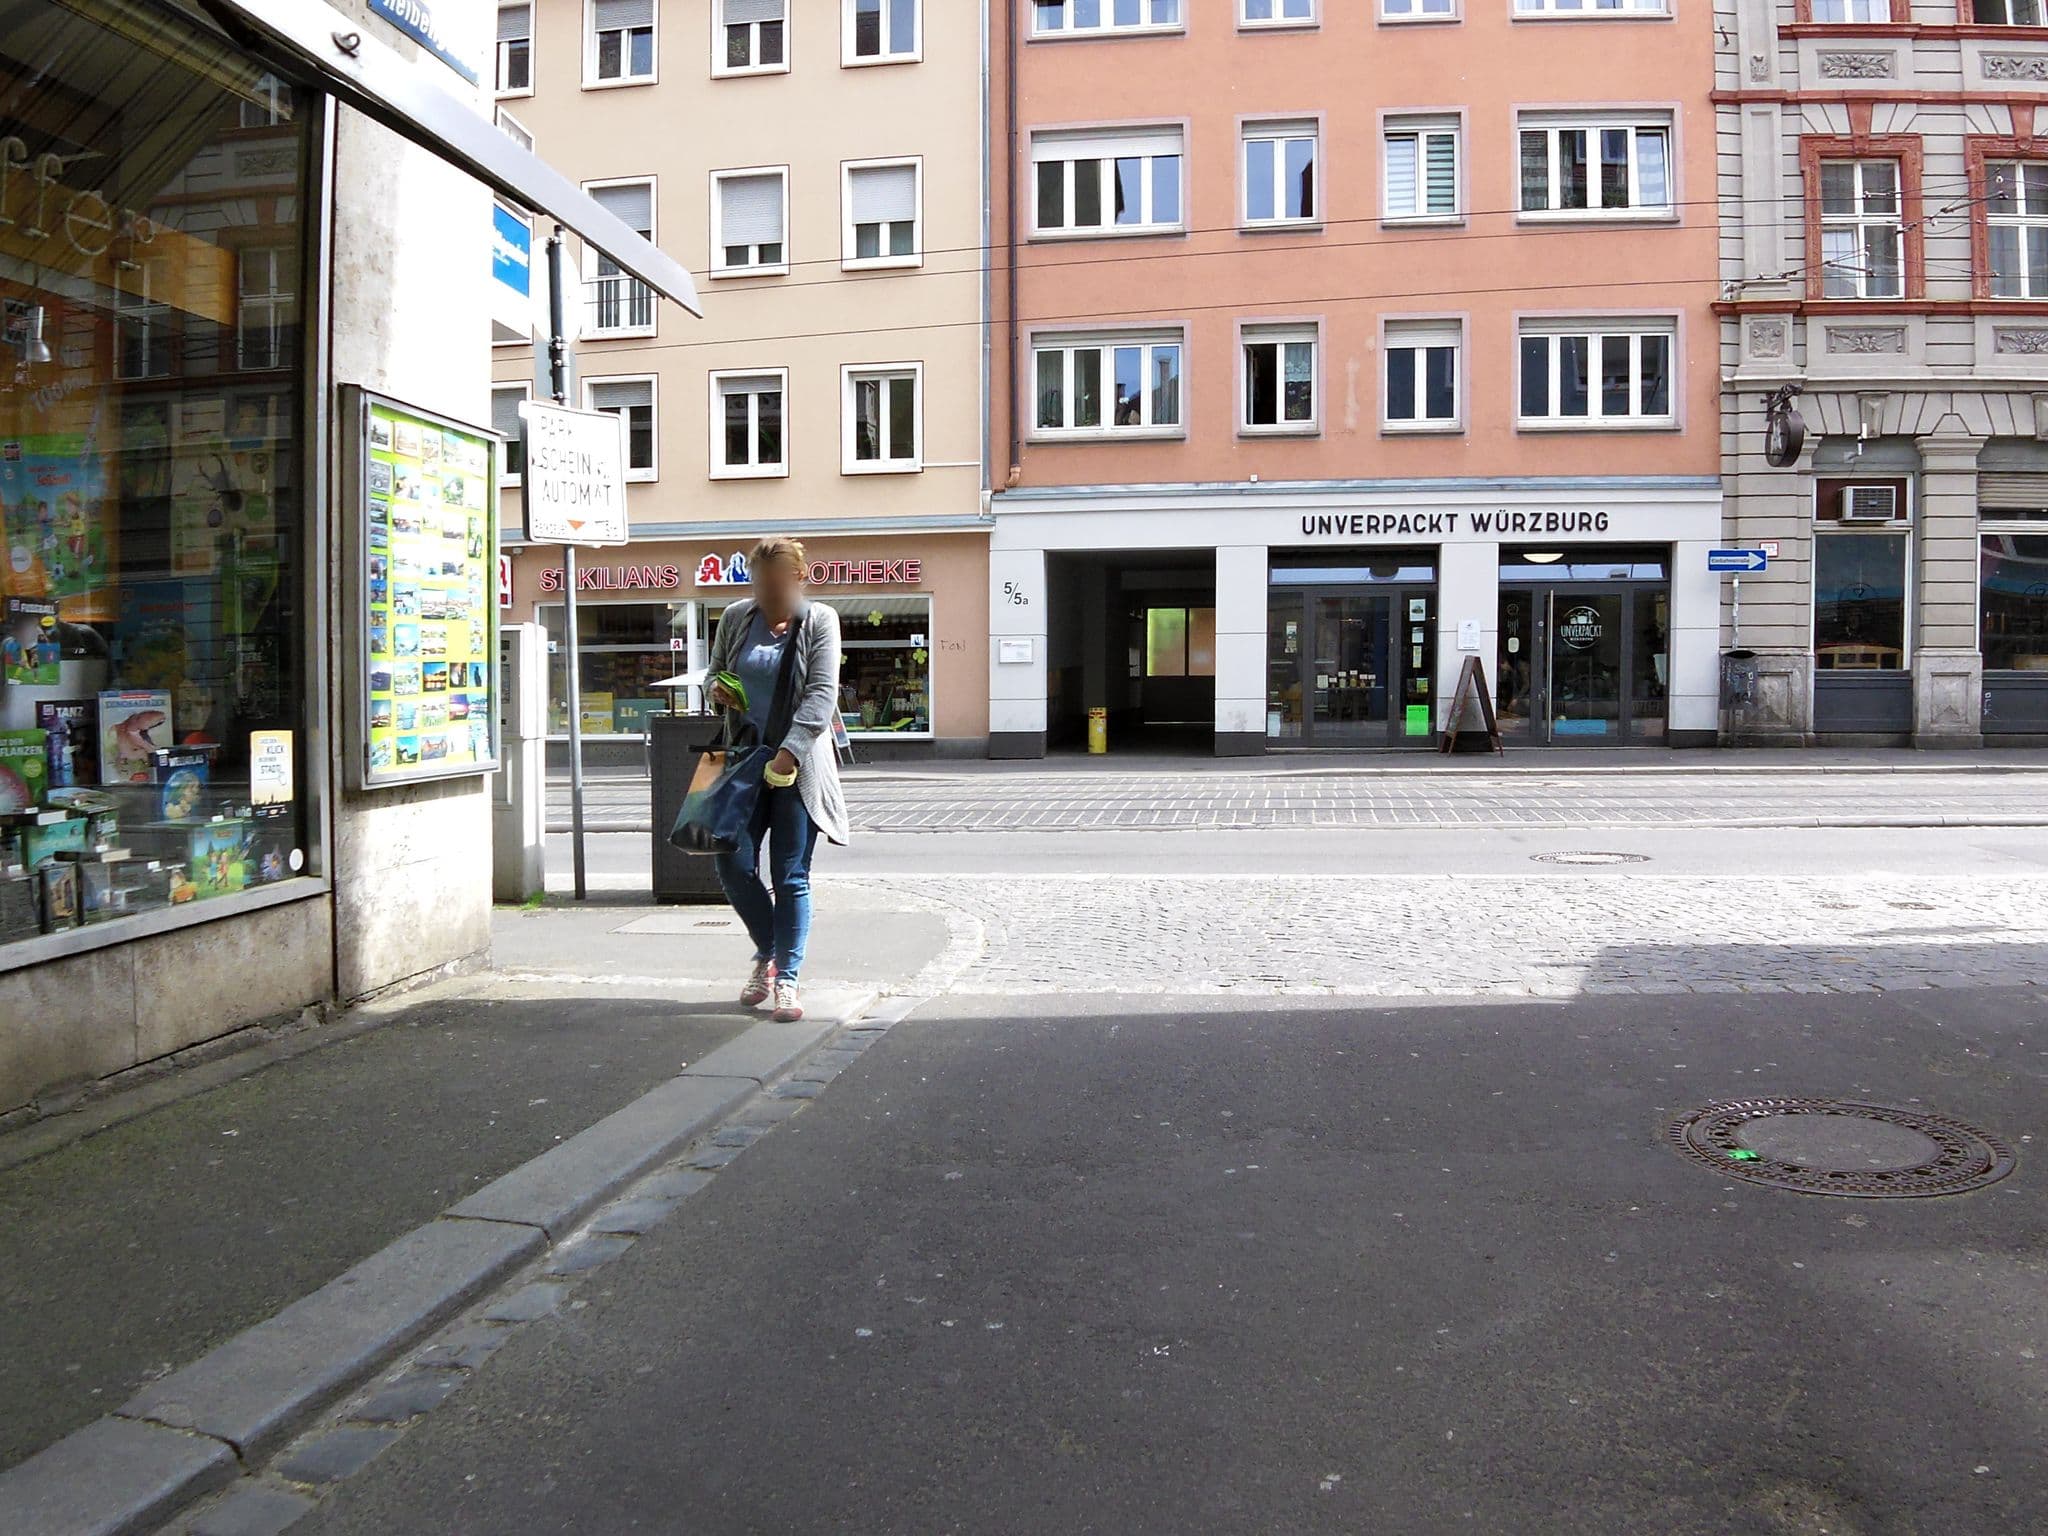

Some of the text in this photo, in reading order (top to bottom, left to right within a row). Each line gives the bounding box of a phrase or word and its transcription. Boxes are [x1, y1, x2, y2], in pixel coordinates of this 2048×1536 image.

[542, 479, 612, 506] AUTOMAT
[1302, 509, 1609, 535] UNVERPACKT WÜRZBURG
[578, 564, 680, 591] KILIANS
[808, 559, 922, 585] OTHEKE
[1560, 624, 1602, 637] UNVERPACKT
[55, 706, 84, 718] TANZ
